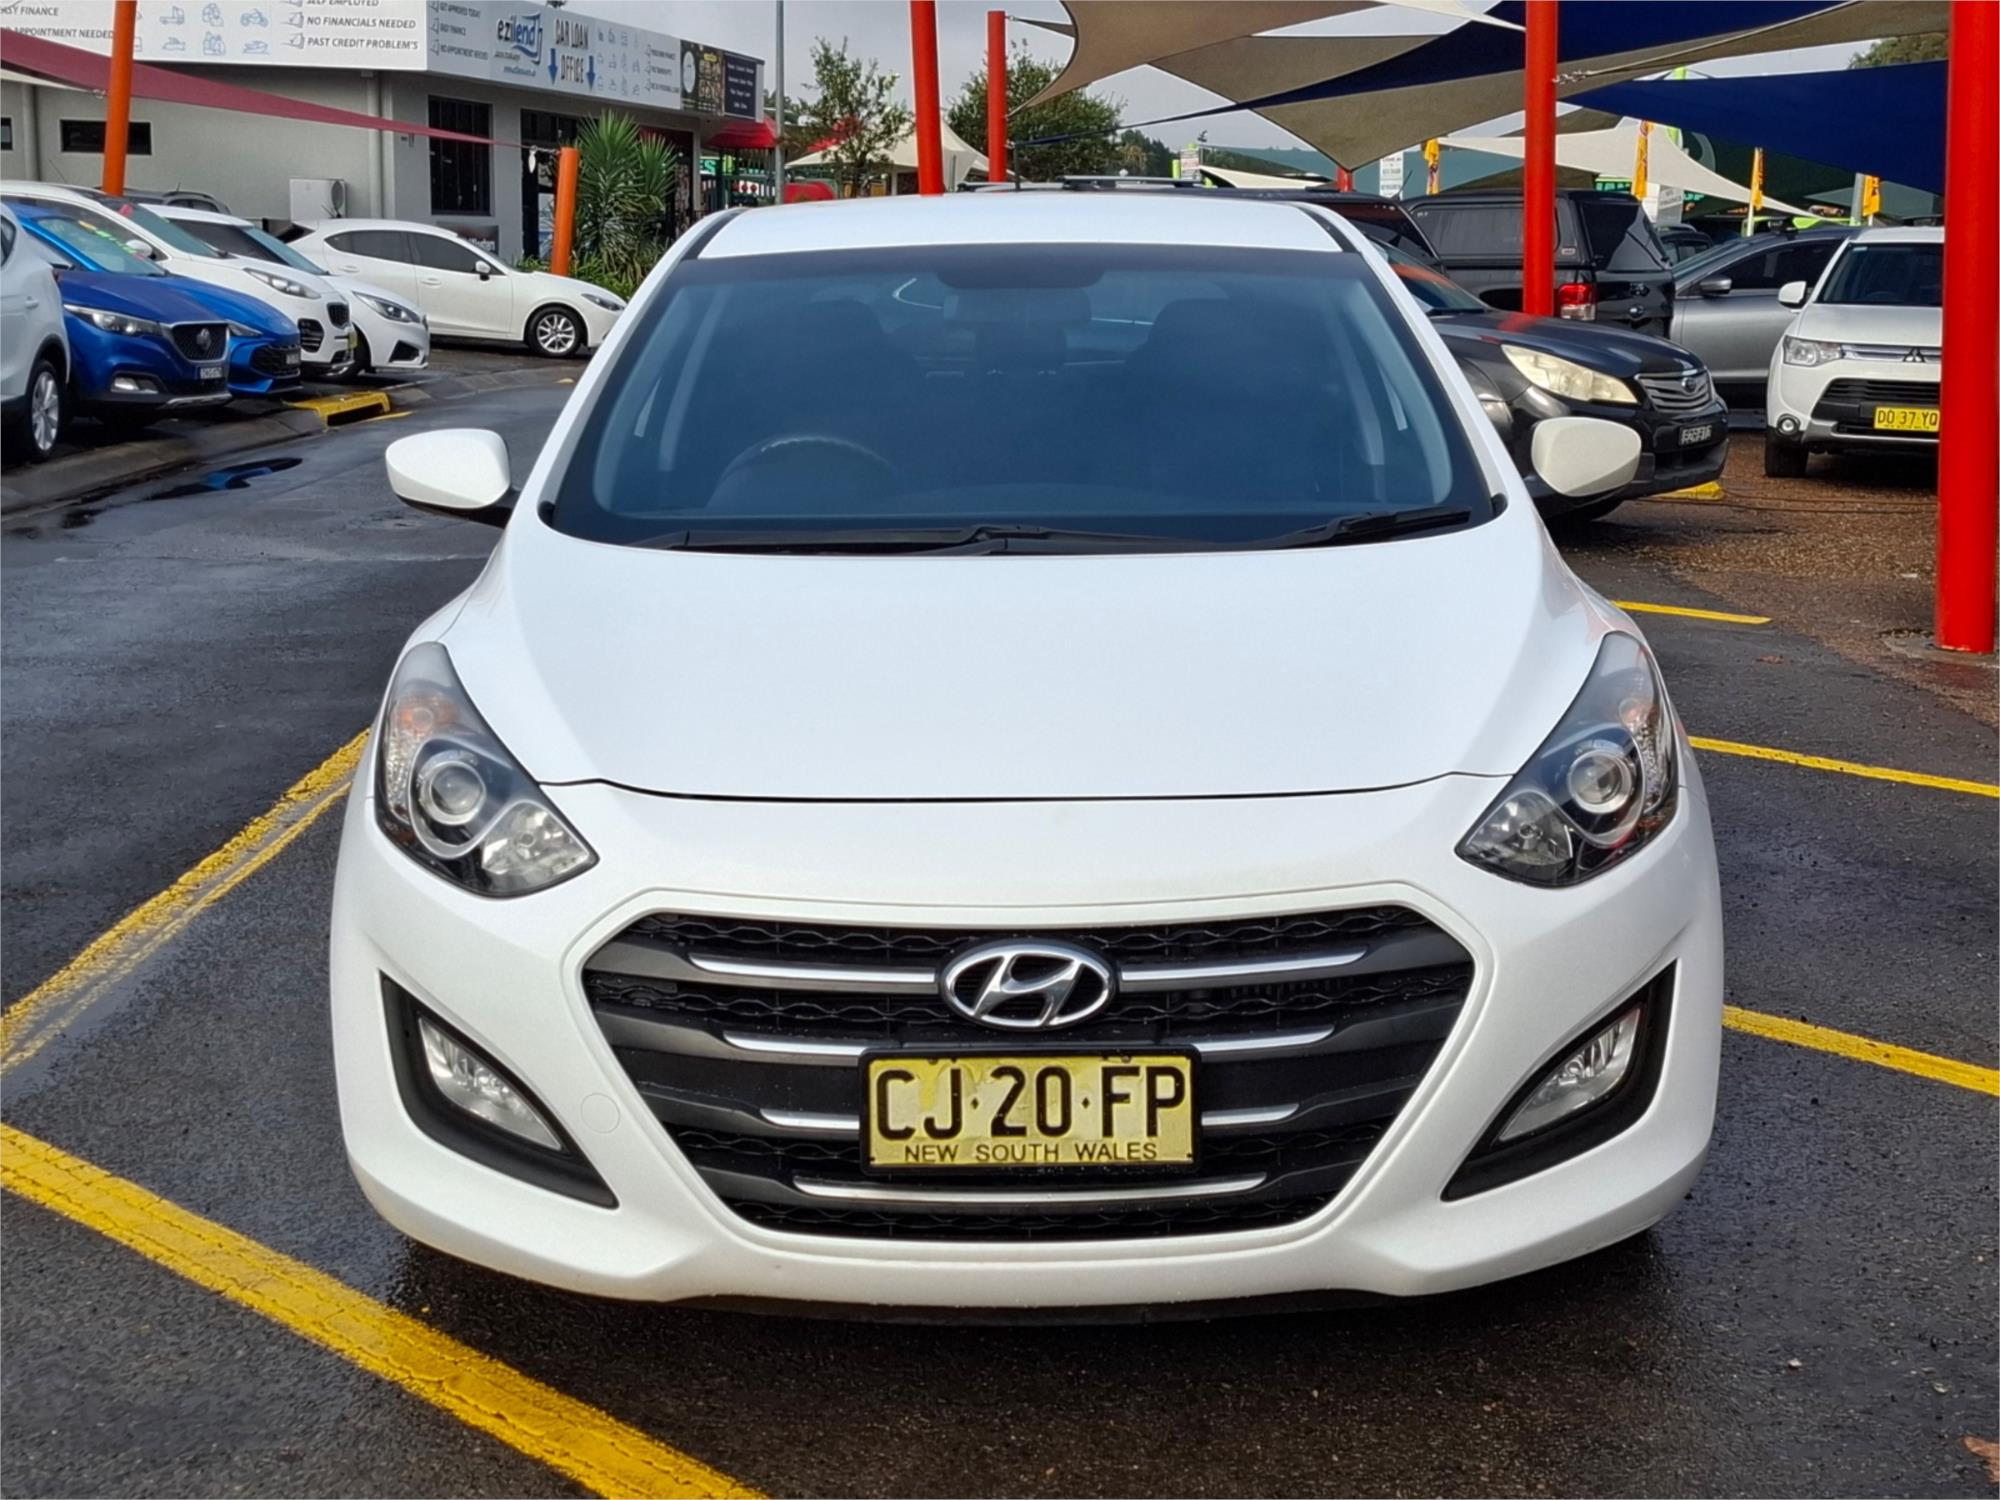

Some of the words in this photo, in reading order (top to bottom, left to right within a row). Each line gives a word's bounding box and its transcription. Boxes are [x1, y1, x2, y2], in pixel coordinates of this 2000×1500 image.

[20, 6, 59, 16] FINANCE
[307, 16, 321, 25] NO
[323, 17, 377, 28] FINANCIALS
[379, 19, 417, 29] NEEDED
[497, 17, 537, 47] ezilend
[307, 37, 331, 47] PAST
[332, 38, 365, 48] CREDIT
[366, 39, 419, 50] PROBLEM'S
[561, 54, 584, 84] OFFICE
[904, 1144, 959, 1163] NEW
[975, 1143, 1059, 1162] SOUTH
[1074, 1142, 1157, 1161] WALES
